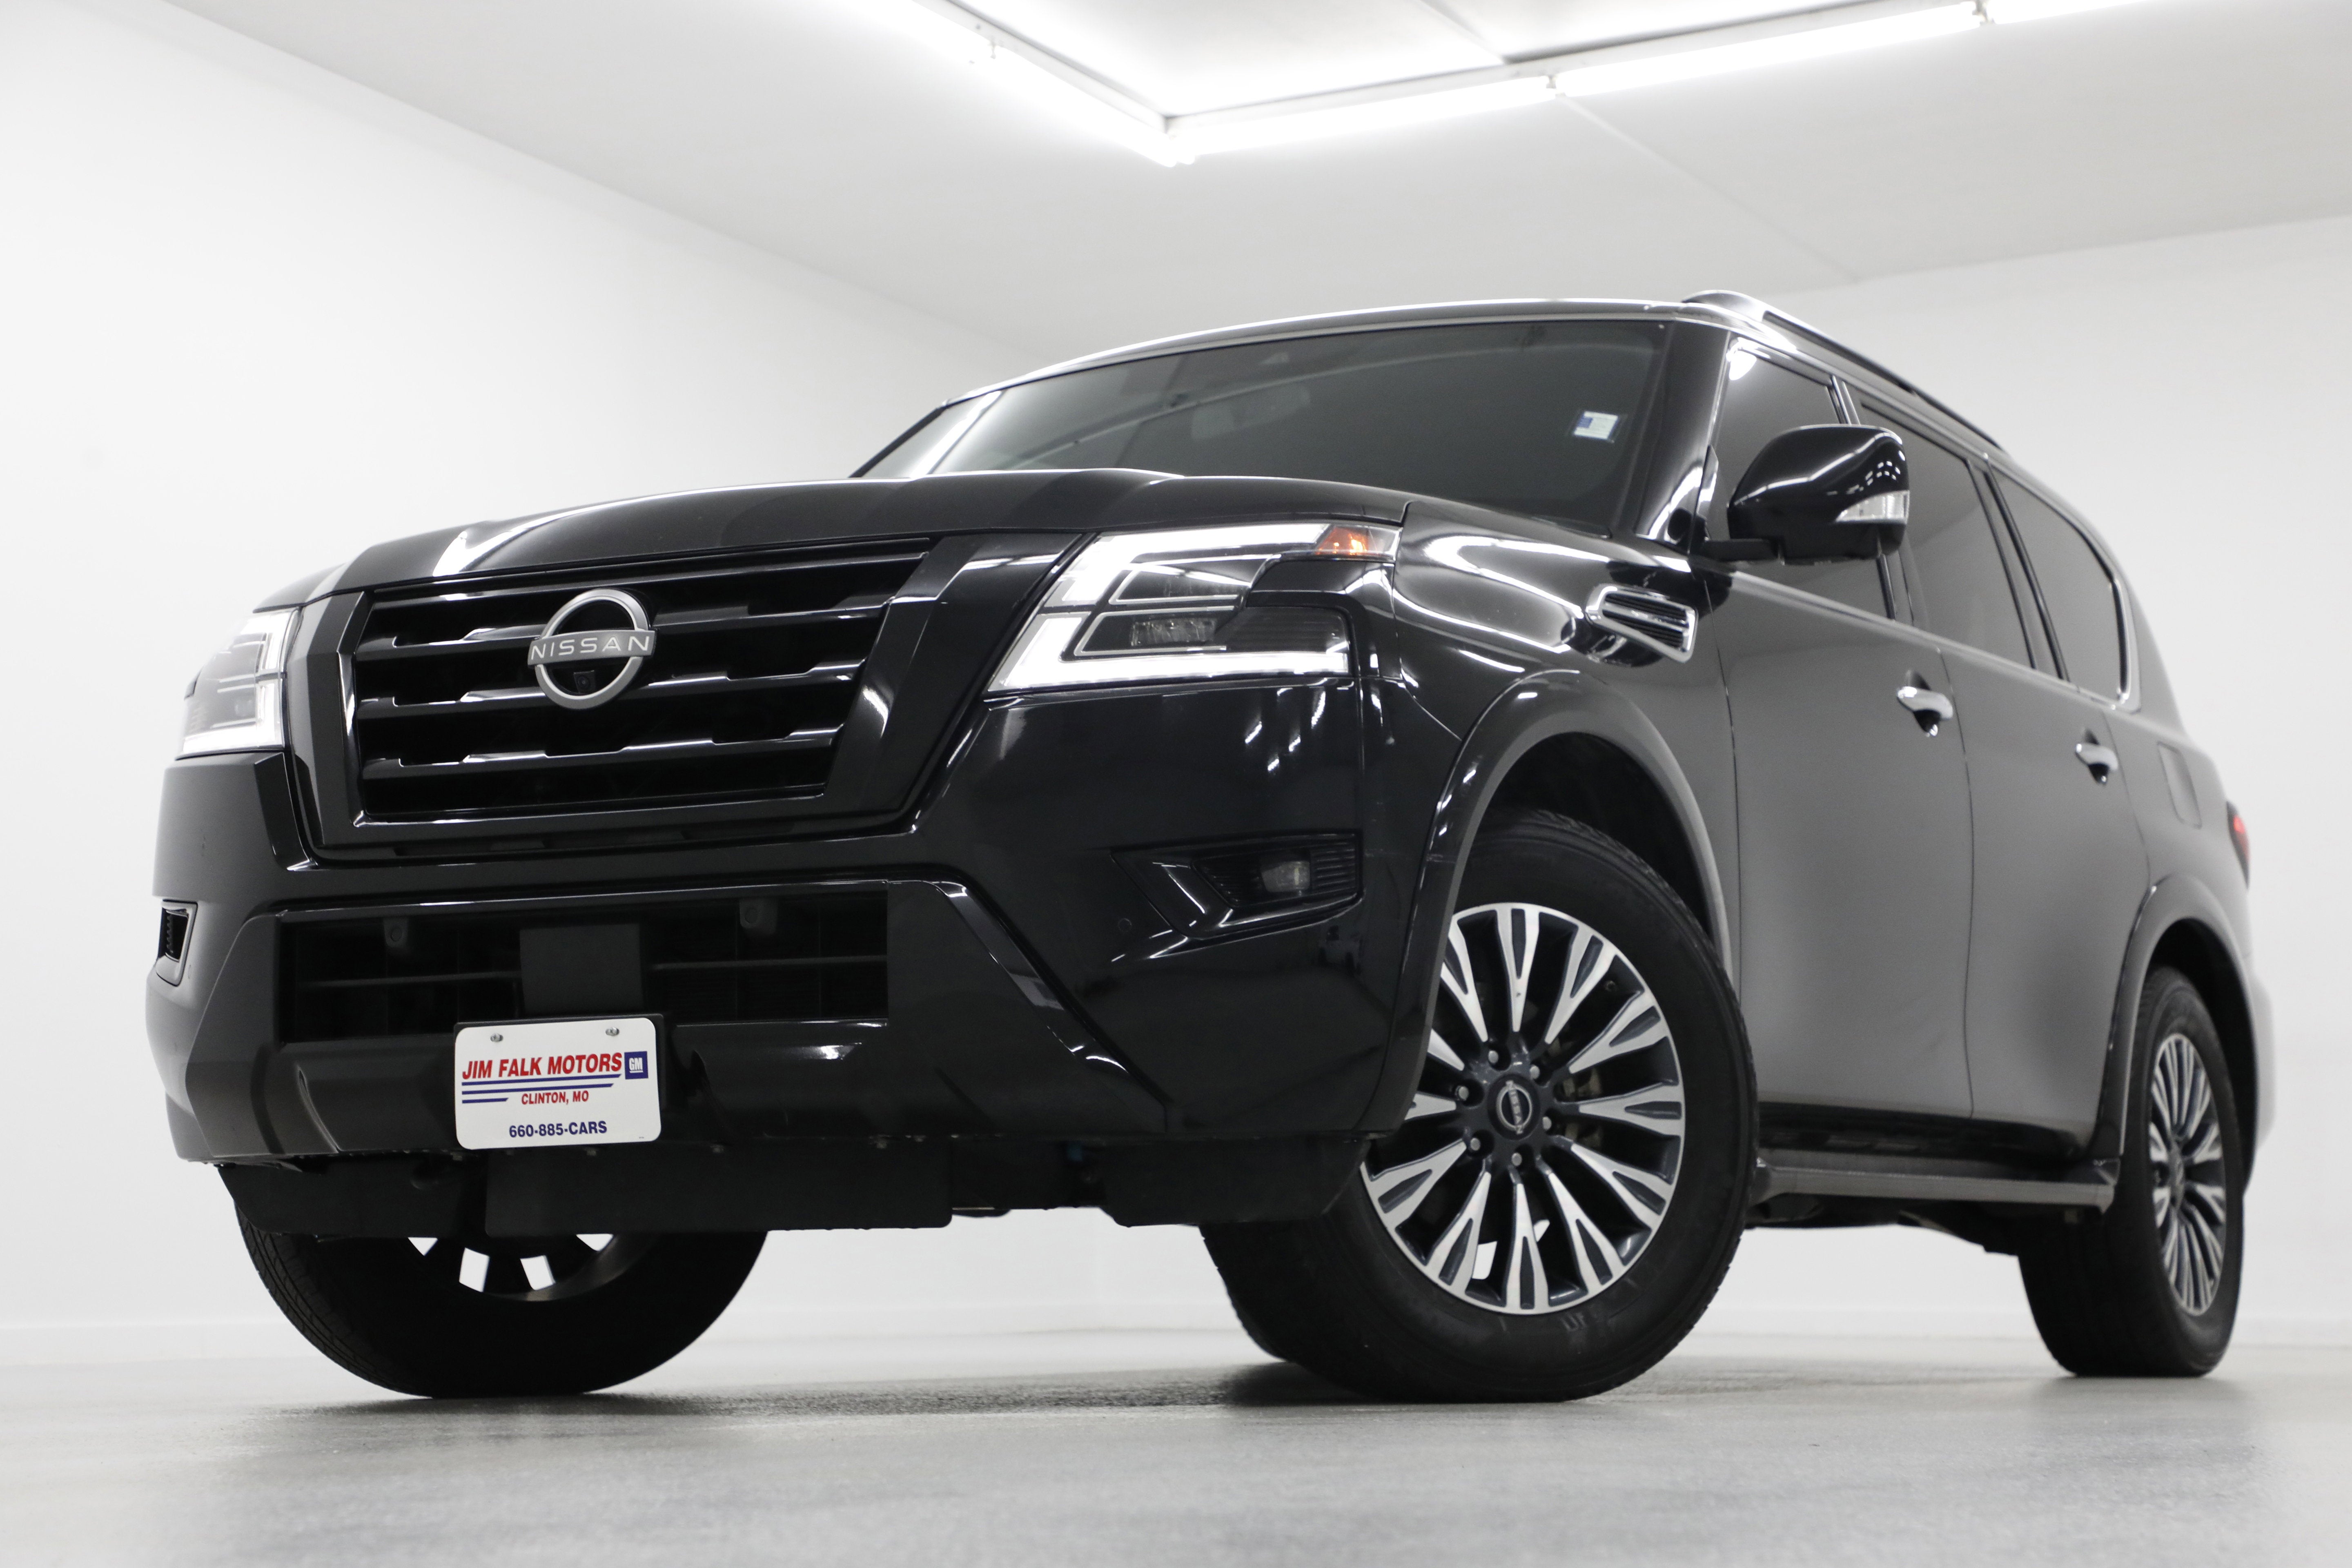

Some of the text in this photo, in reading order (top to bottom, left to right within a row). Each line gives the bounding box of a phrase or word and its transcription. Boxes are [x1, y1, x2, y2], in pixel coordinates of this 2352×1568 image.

[531, 636, 650, 660] NISSAN
[462, 1052, 622, 1080] JIM FALK MOTORS
[629, 1057, 643, 1071] GM
[521, 1090, 589, 1105] CLINTON, MO
[509, 1120, 607, 1138] 660-885-CARS
